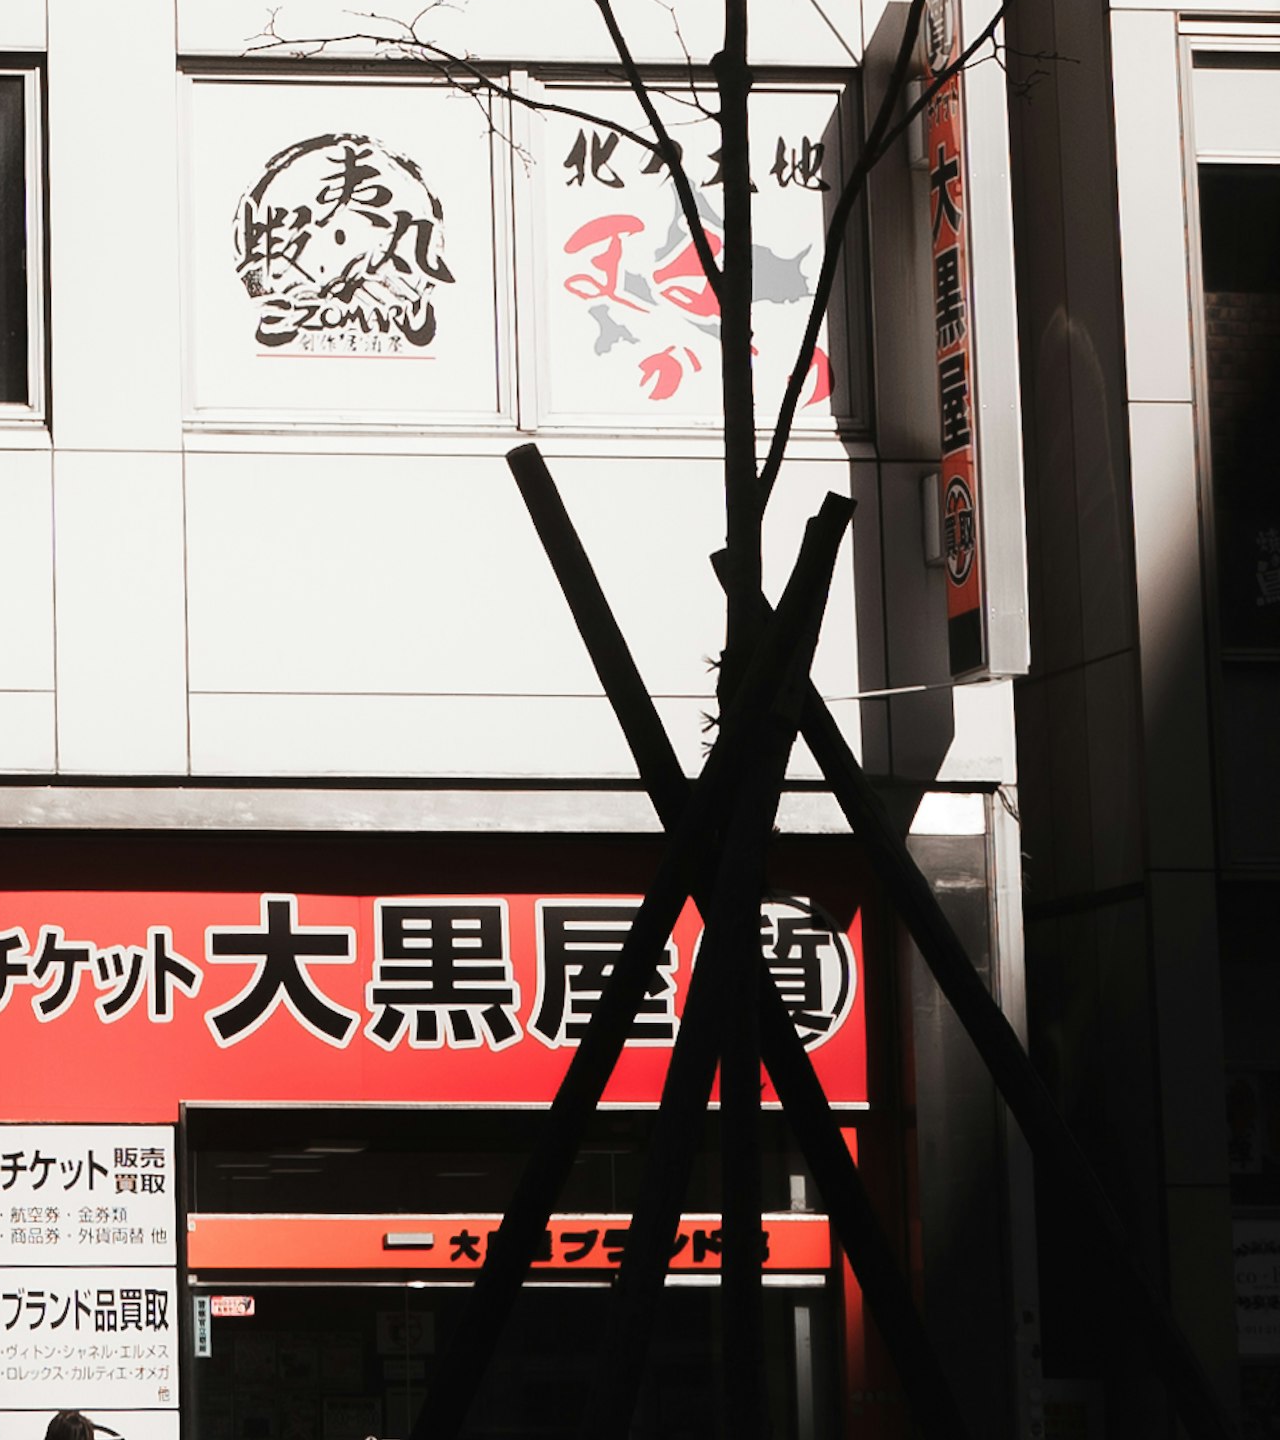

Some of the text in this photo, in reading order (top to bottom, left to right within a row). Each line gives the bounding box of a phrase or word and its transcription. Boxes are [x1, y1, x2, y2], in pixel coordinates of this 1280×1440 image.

[929, 144, 974, 458] 大黒屋
[1, 1150, 109, 1191] チケット
[114, 1147, 165, 1168] 販売
[114, 1174, 165, 1194] 買取
[2, 1288, 169, 1332] ブランド品買取
